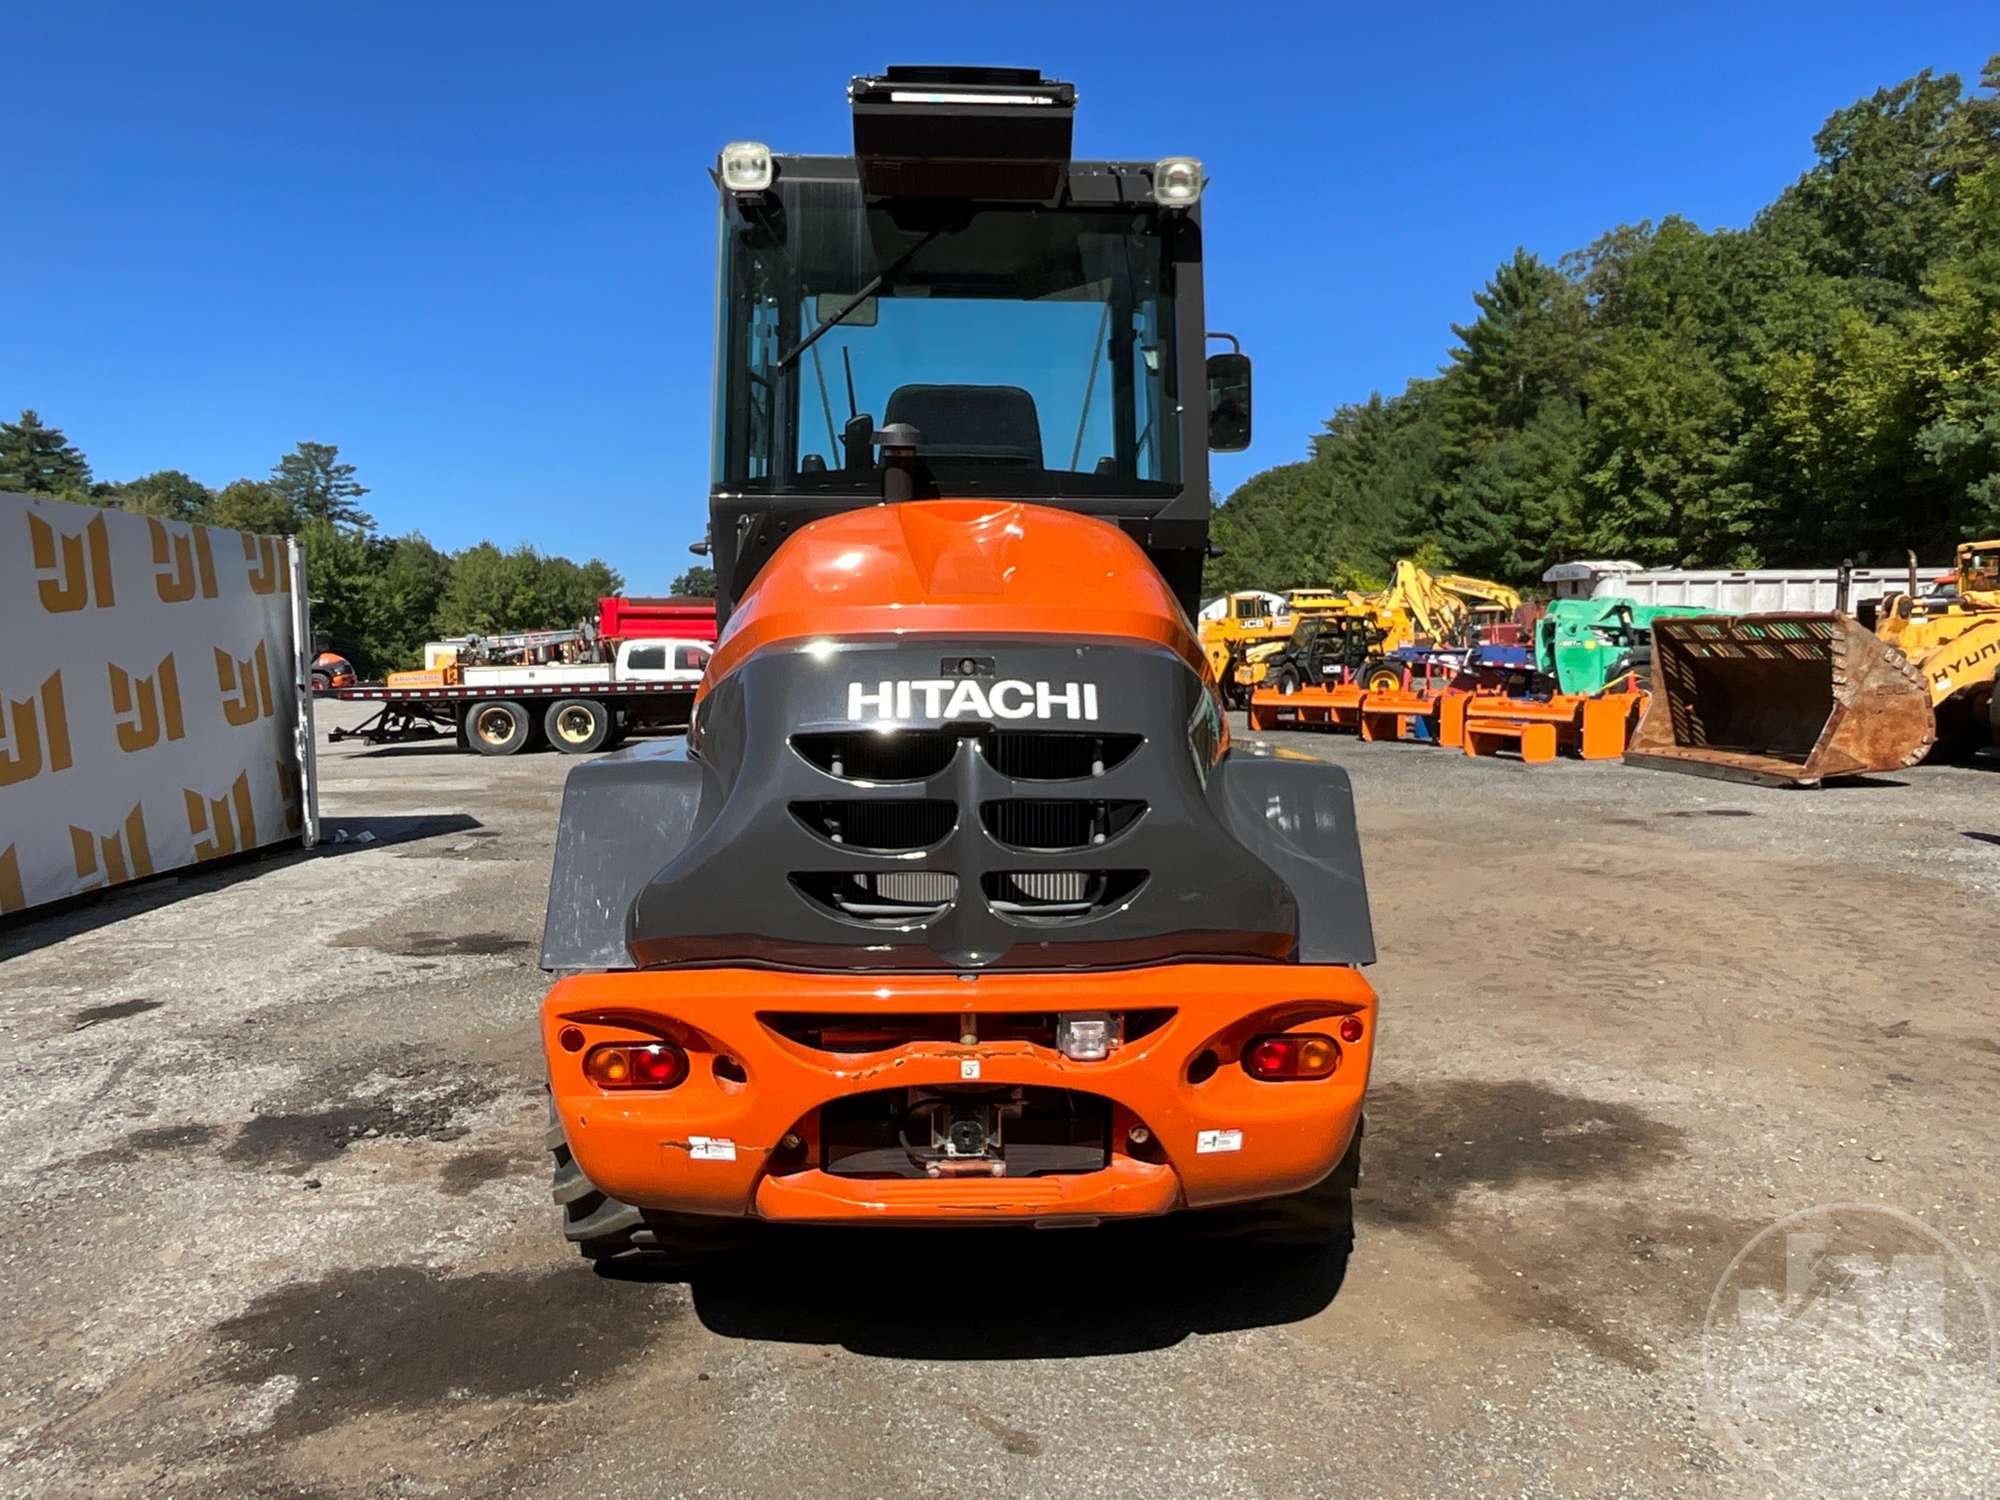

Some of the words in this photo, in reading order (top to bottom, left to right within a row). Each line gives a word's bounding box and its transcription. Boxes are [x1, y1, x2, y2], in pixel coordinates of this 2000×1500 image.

[1239, 618, 1265, 629] JCB
[1932, 640, 2000, 683] HYUN
[847, 679, 1099, 721] HITACHI
